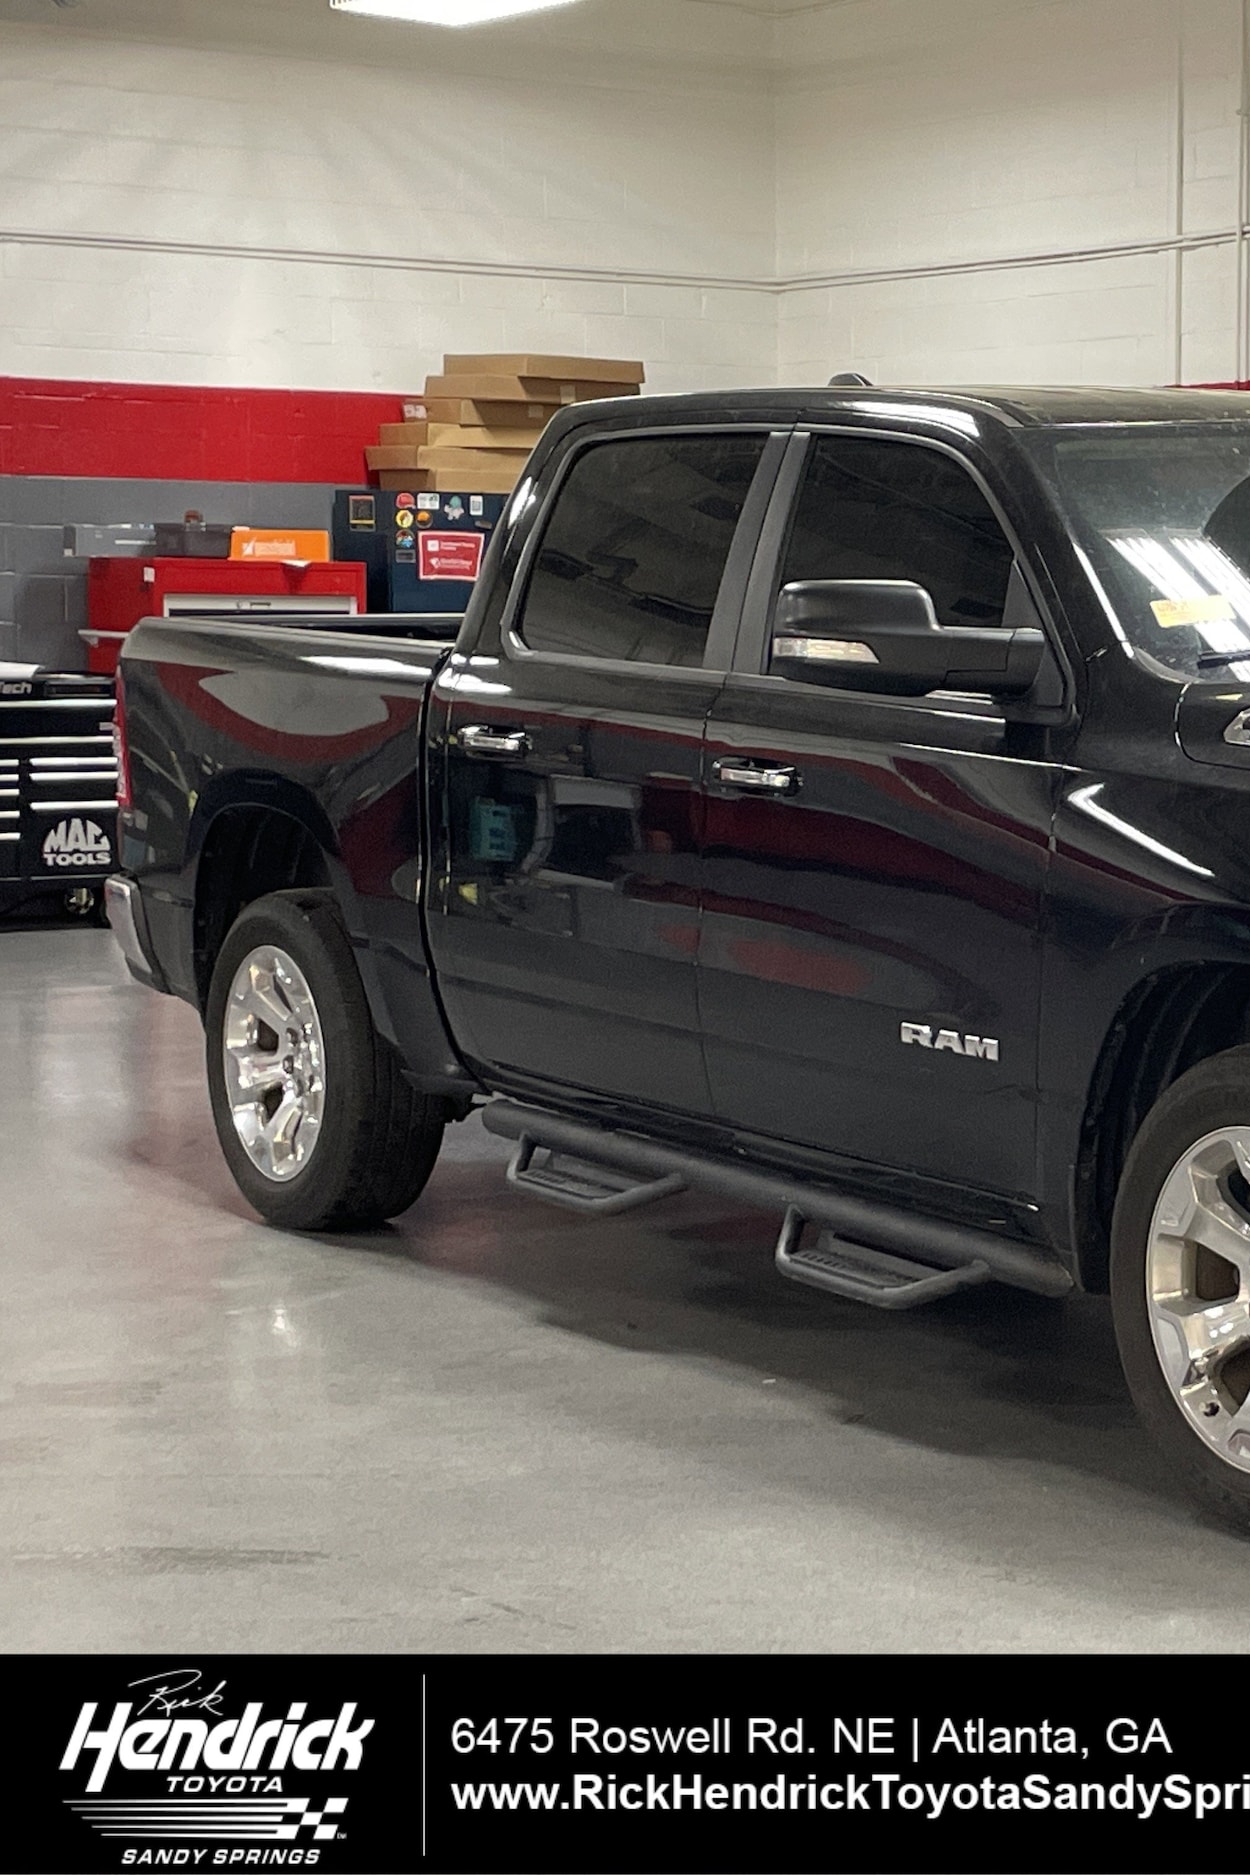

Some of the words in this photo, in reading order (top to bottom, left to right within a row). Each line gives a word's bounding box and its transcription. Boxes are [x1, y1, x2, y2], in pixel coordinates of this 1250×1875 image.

[43, 817, 111, 853] MAC
[43, 852, 112, 867] TOOLS
[900, 1021, 1000, 1062] RAM
